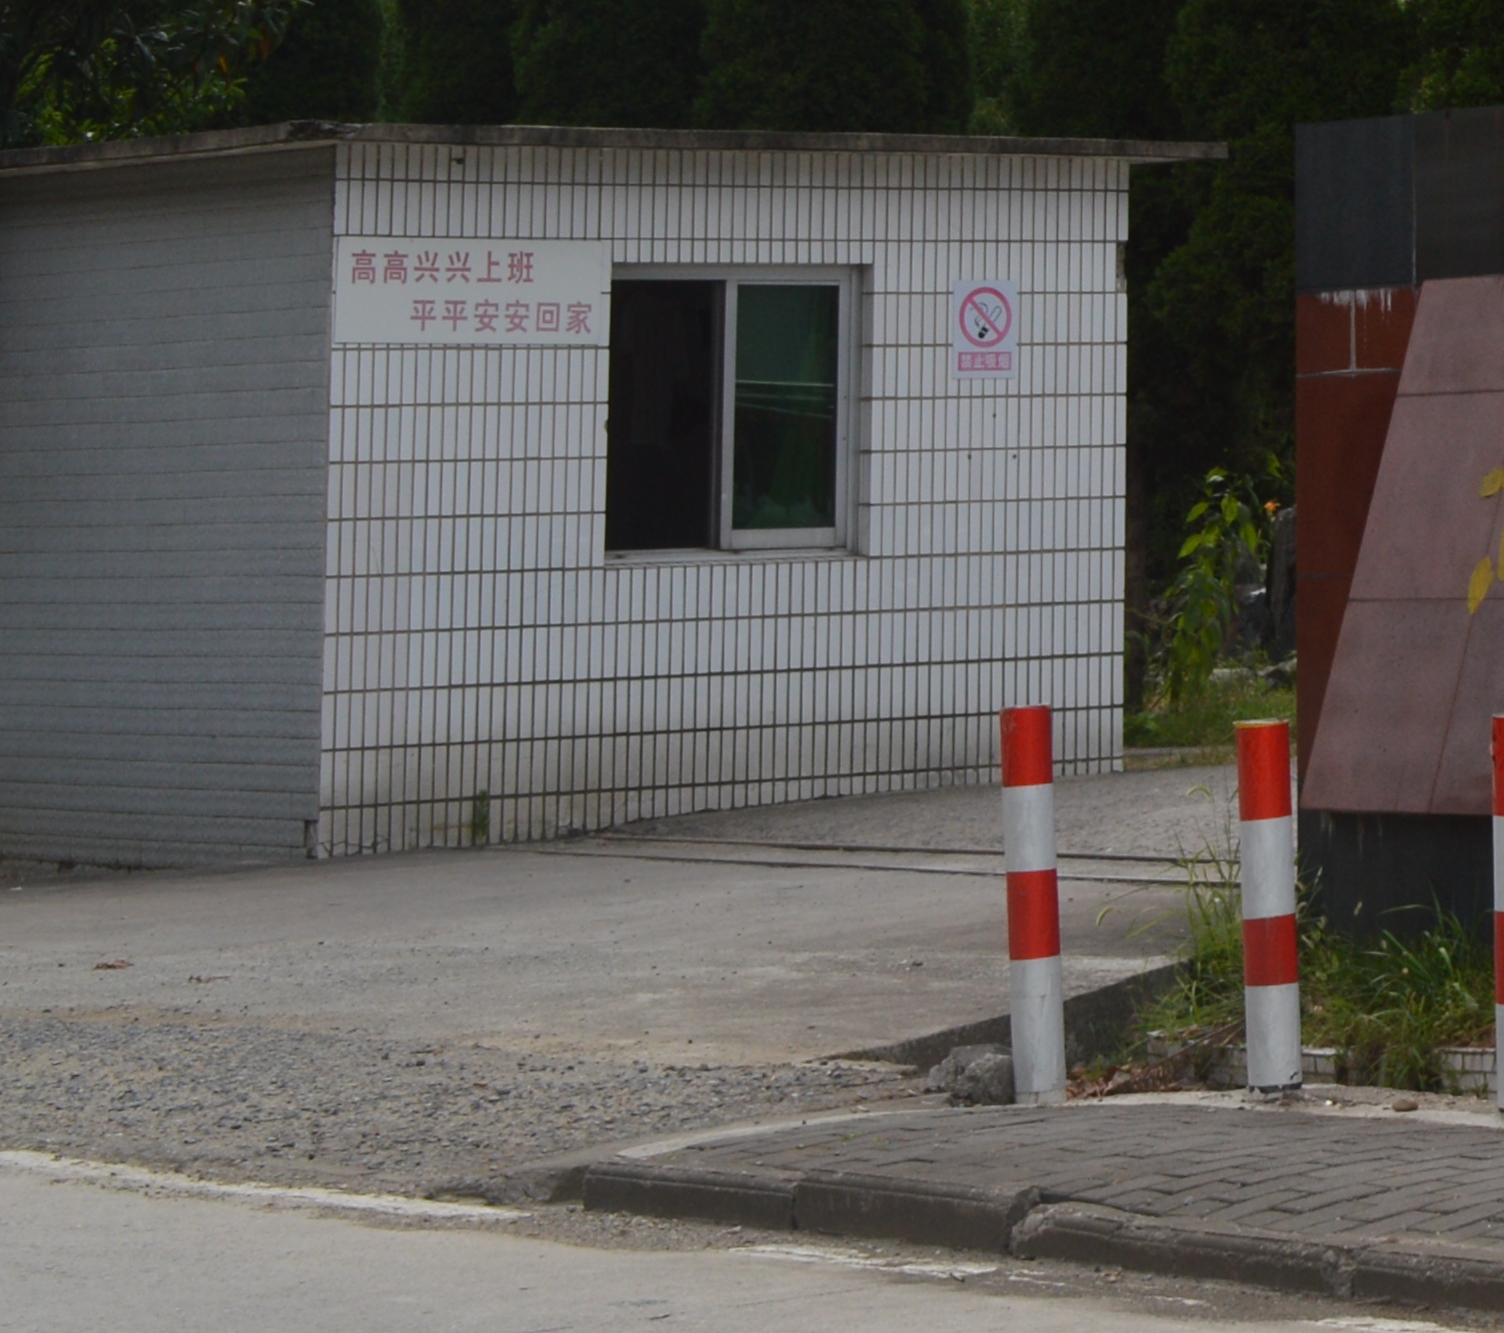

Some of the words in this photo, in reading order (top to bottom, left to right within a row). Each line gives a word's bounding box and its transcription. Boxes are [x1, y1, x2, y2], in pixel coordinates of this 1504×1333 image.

[351, 249, 535, 284] 高高兴兴上班
[410, 299, 593, 334] 平平安安回家
